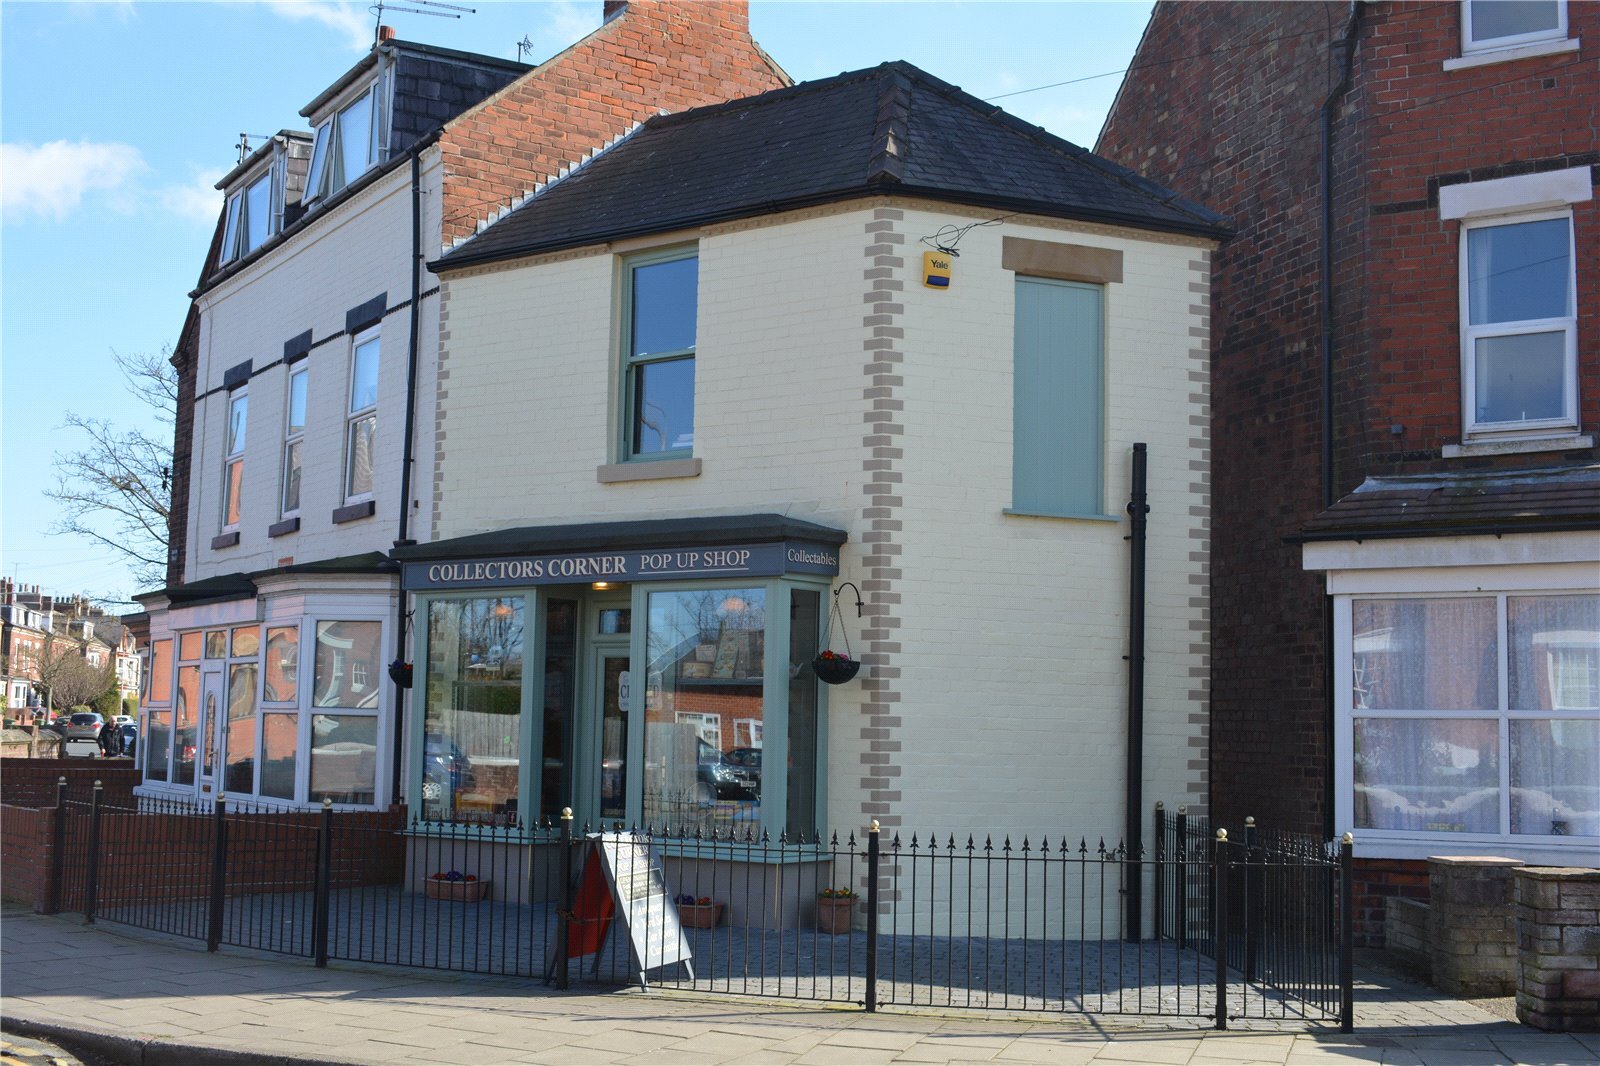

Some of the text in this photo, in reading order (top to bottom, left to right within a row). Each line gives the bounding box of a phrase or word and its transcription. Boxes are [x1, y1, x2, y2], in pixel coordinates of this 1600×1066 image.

[931, 259, 949, 270] Yale
[640, 549, 750, 570] POP UP SHOP
[787, 548, 837, 566] Collectables
[428, 556, 627, 582] COLLECTORS CORNER
